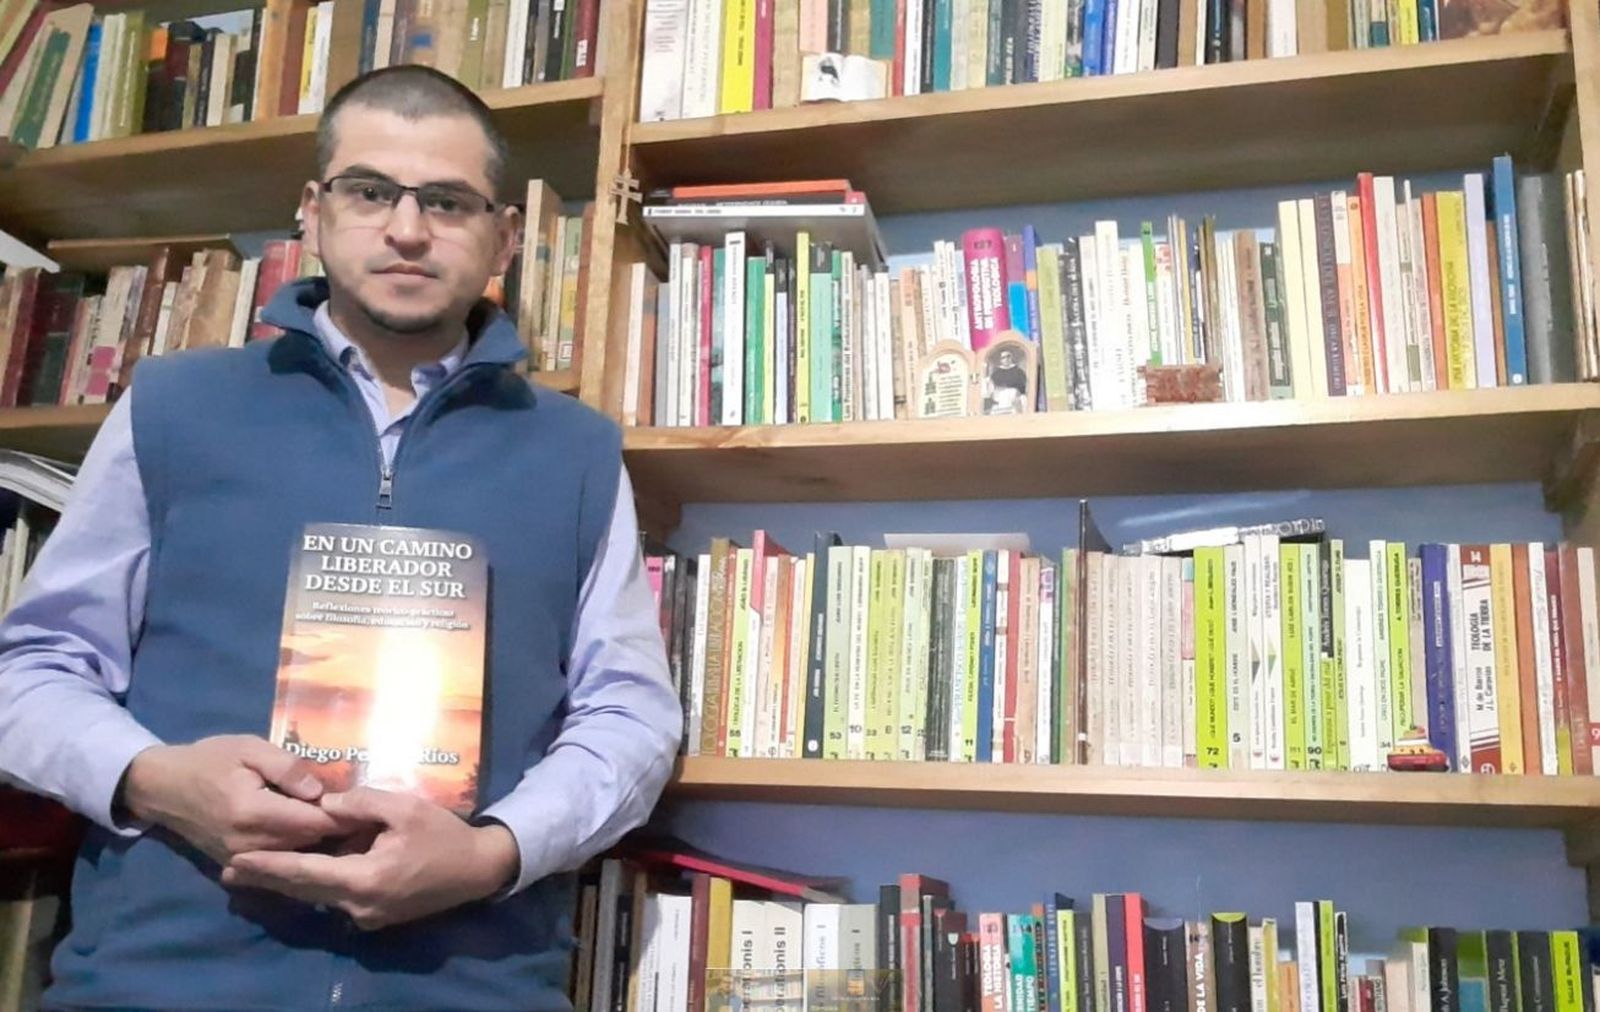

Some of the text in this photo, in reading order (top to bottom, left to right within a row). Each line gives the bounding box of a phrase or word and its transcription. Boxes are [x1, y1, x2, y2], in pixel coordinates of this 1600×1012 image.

[303, 534, 473, 564] EN UN CAMINO
[321, 554, 453, 578] LIBERADOR
[305, 574, 467, 602] DESDE EL SUR
[312, 600, 373, 615] Reflexiones
[295, 612, 324, 624] sobre
[1480, 599, 1493, 652] DE LA TIERRA
[1232, 732, 1240, 742] 5
[286, 741, 343, 764] Diego
[1206, 747, 1218, 756] 72
[1307, 746, 1321, 755] 90
[774, 926, 787, 936] II
[982, 944, 993, 996] TEOLOGIA
[1194, 953, 1204, 980] VIDA
[1195, 983, 1205, 997] LA
[993, 995, 1004, 1010] LA
